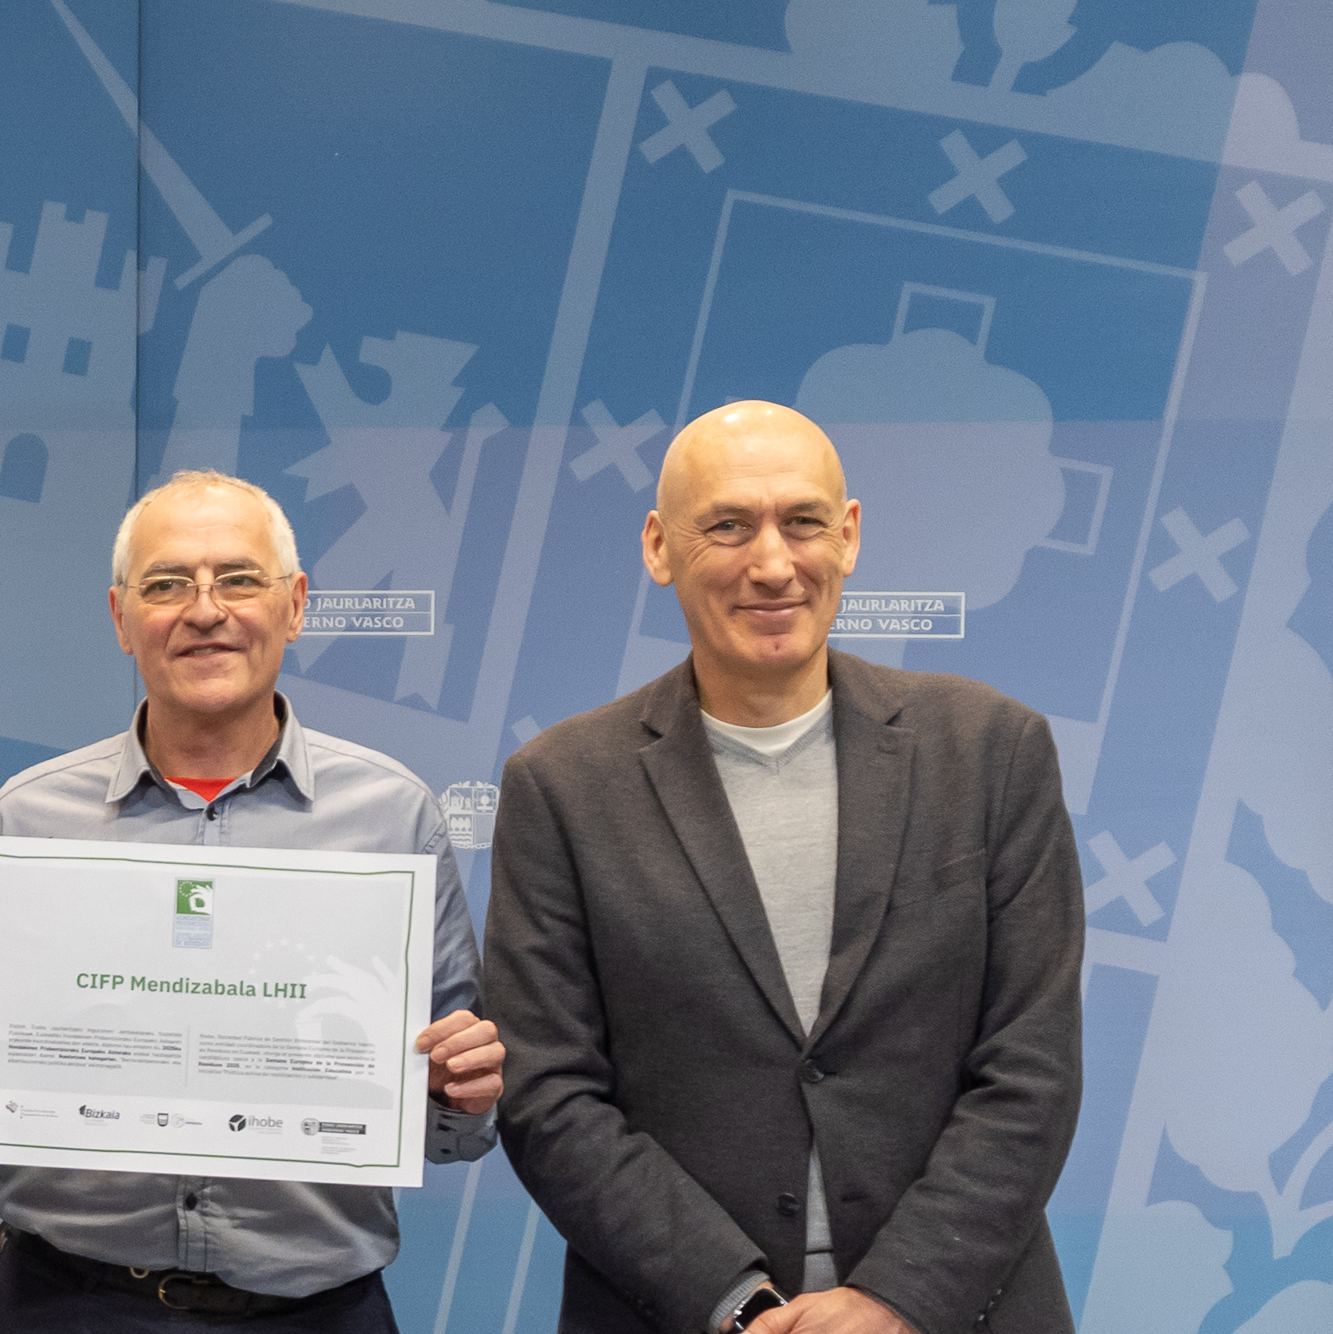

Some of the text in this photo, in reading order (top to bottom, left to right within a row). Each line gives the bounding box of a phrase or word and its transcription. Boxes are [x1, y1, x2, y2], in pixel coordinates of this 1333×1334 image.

[316, 597, 415, 612] JAURLARITZA
[841, 599, 944, 614] JAURLARITZA
[351, 616, 404, 628] VASCO
[877, 619, 933, 631] VASCO
[76, 971, 308, 999] CIFP Mendizabala LHII
[85, 1108, 120, 1120] Bizkaia
[247, 1115, 284, 1129] ihobe
